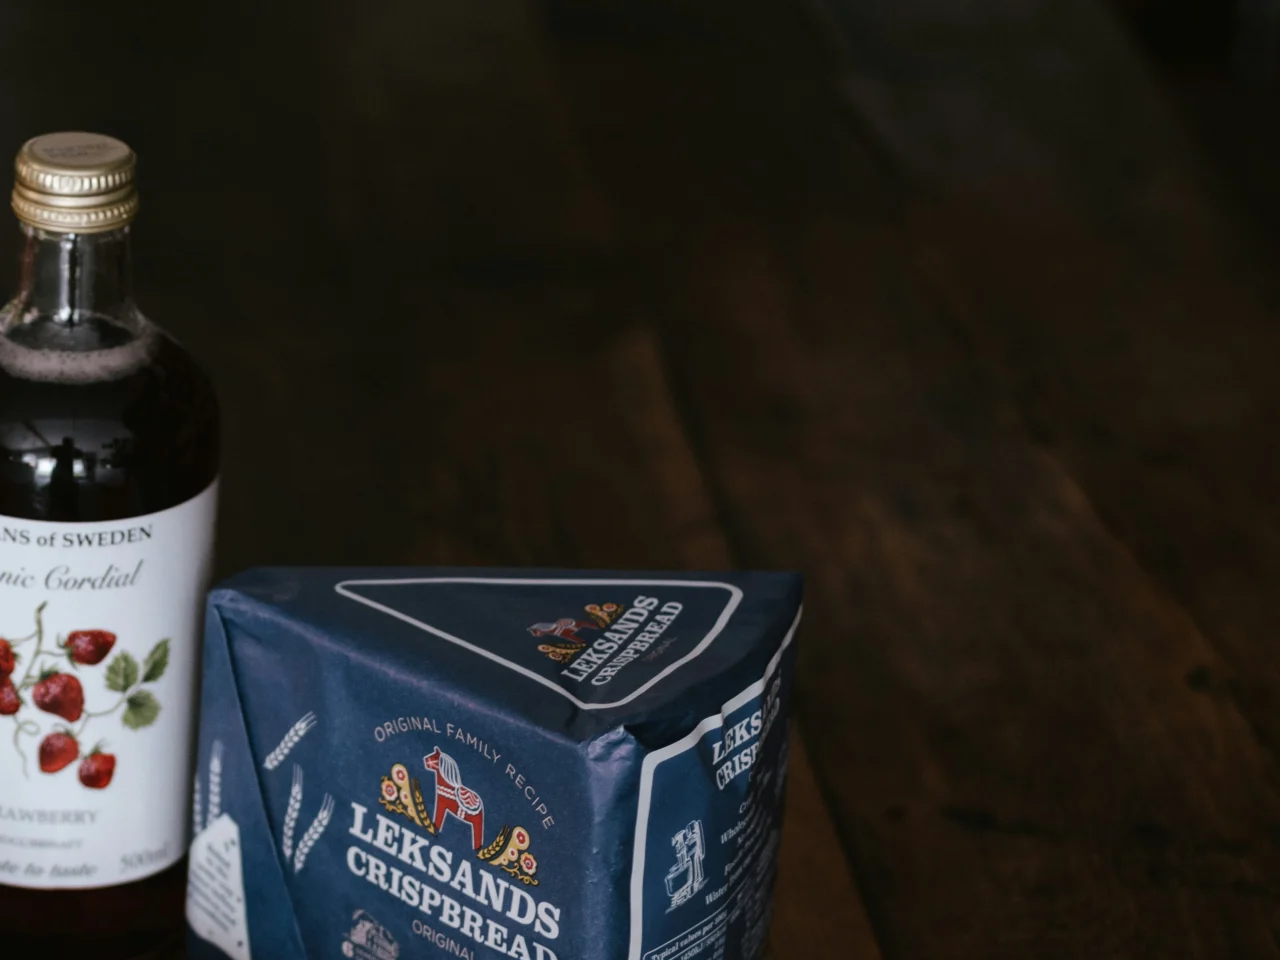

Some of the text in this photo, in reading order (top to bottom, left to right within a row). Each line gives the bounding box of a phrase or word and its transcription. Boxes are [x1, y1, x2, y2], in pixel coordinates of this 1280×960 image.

[36, 531, 56, 547] of
[62, 524, 153, 548] SWEDEN
[44, 558, 144, 591] Cordial
[561, 595, 659, 683] LEKSANDS
[591, 601, 683, 686] CRISPBREAD
[374, 716, 555, 830] ORIGINAL FAMILY RECIPE
[348, 802, 561, 940] LEKSANDS
